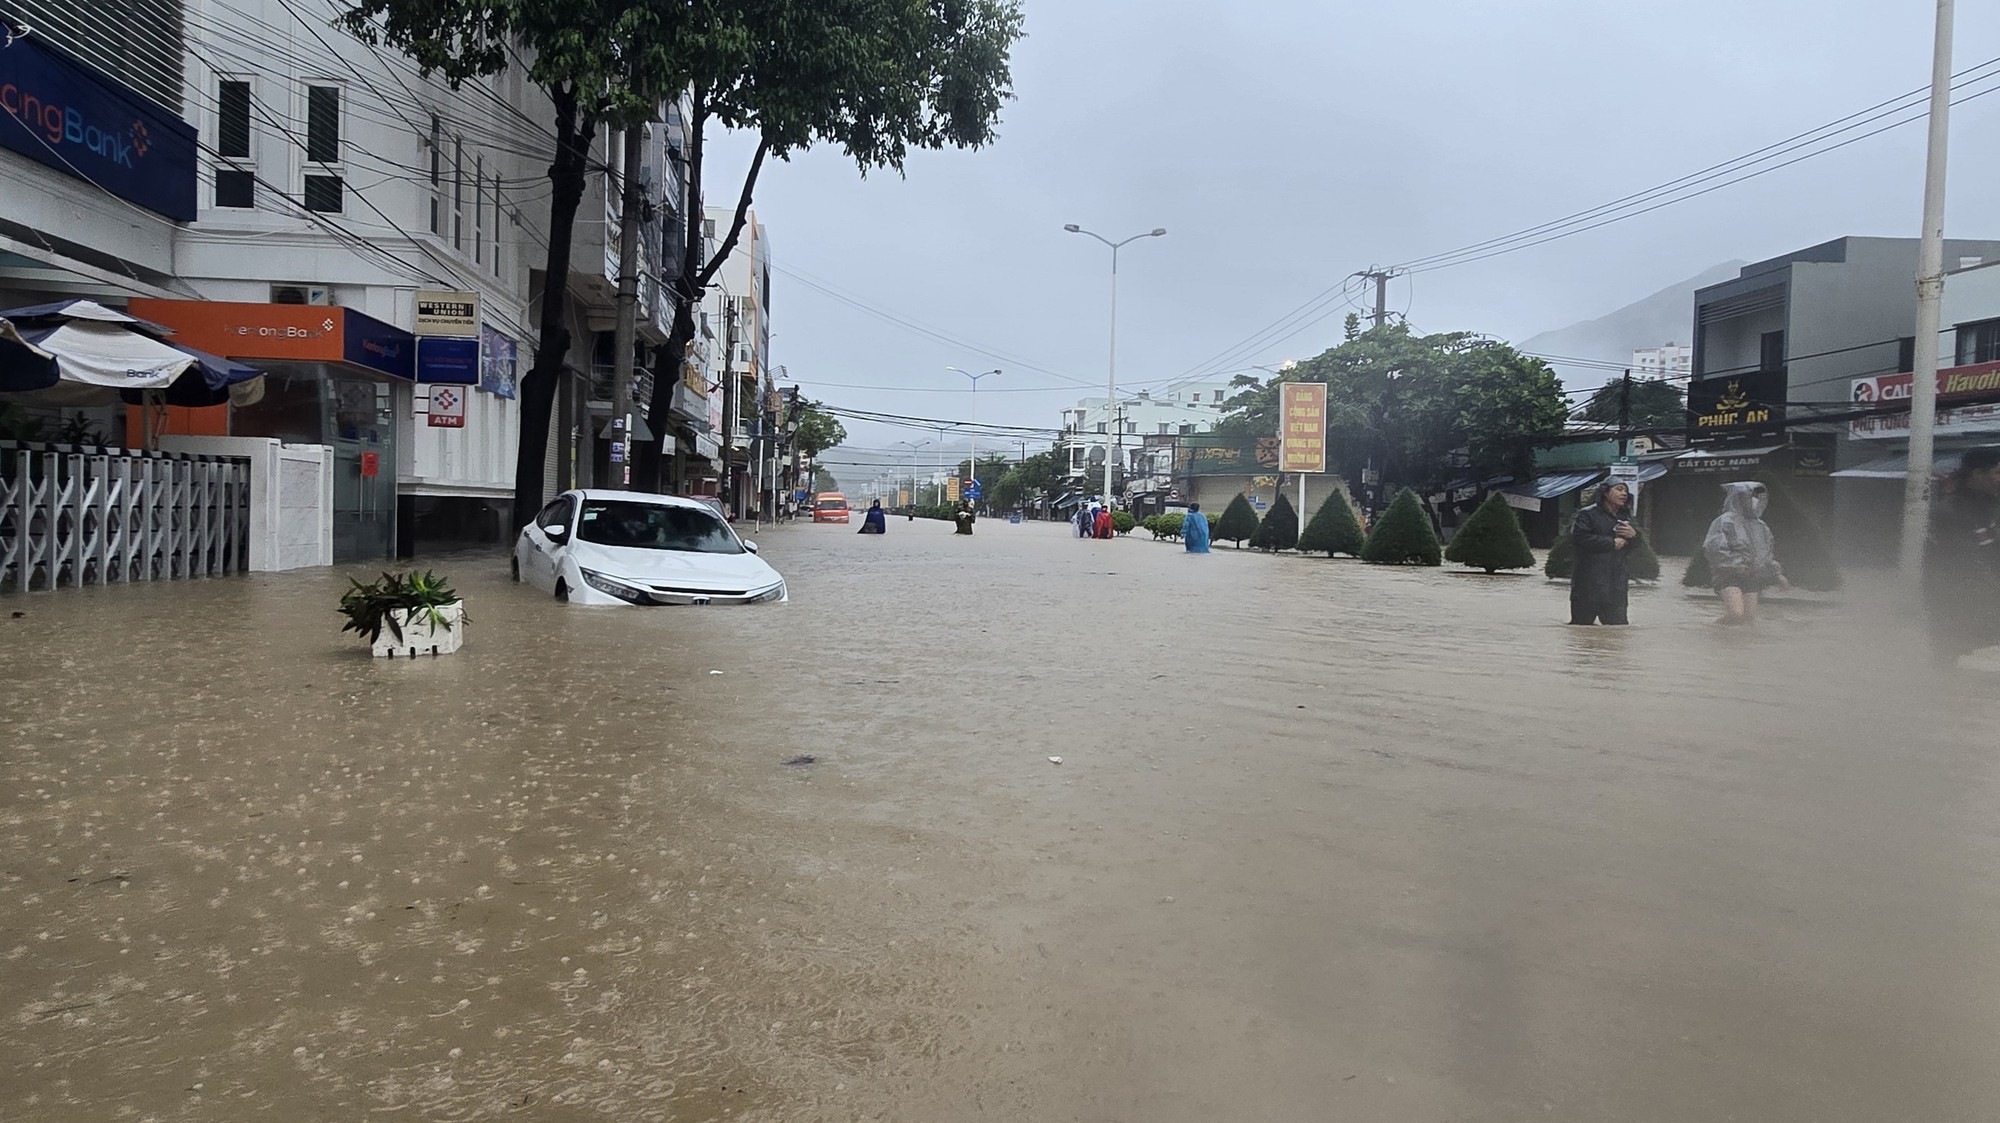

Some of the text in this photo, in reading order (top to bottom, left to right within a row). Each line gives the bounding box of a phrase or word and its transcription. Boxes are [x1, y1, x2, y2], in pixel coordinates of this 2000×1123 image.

[419, 302, 465, 310] WESTERN
[225, 325, 323, 339] KenongBank
[126, 368, 160, 379] Bank
[433, 416, 458, 425] ATM
[1746, 409, 1769, 424] AN
